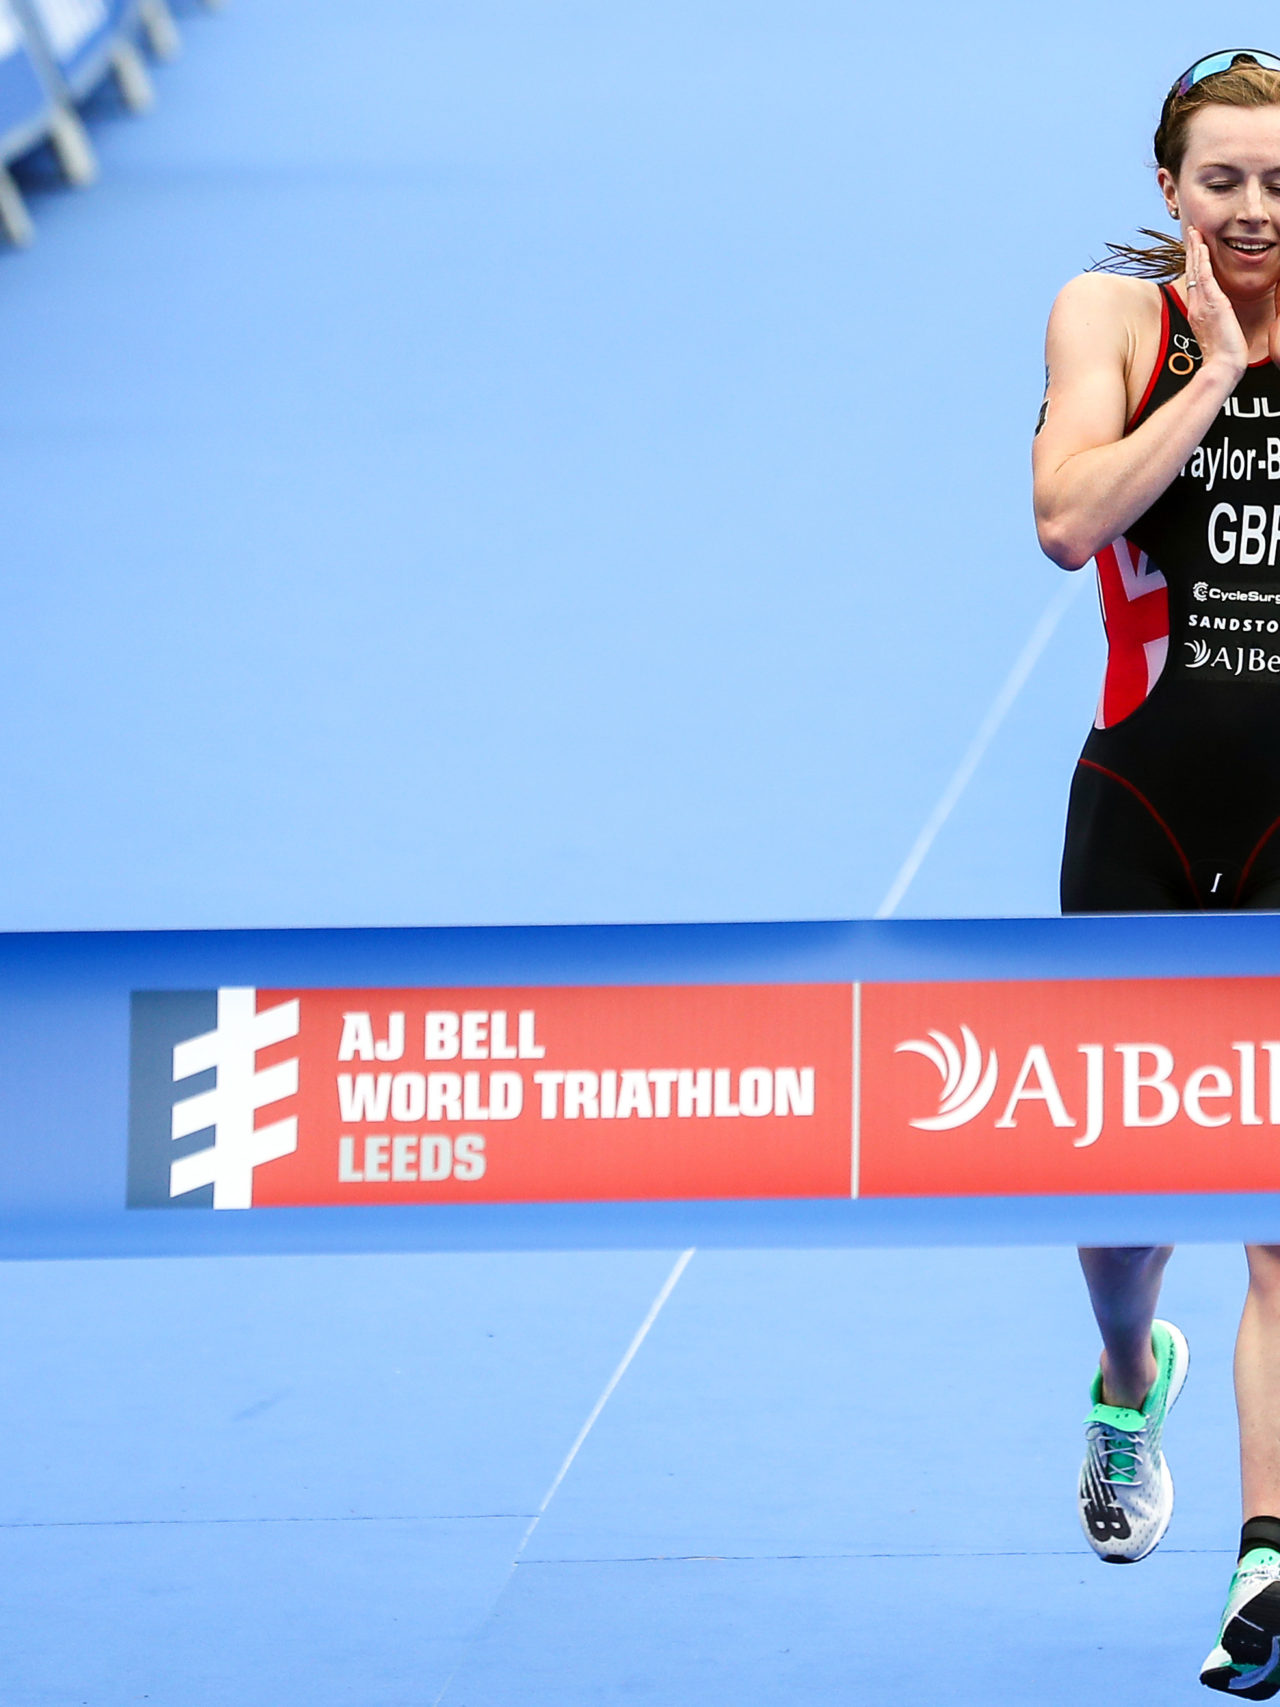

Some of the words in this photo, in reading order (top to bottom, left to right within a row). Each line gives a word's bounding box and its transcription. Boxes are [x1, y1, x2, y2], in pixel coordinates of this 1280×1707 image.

[337, 1011, 406, 1061] AJ
[424, 1010, 546, 1061] BELL
[336, 1070, 523, 1122] WORLD
[533, 1066, 816, 1119] TRIATHLON
[338, 1132, 487, 1182] LEEDS
